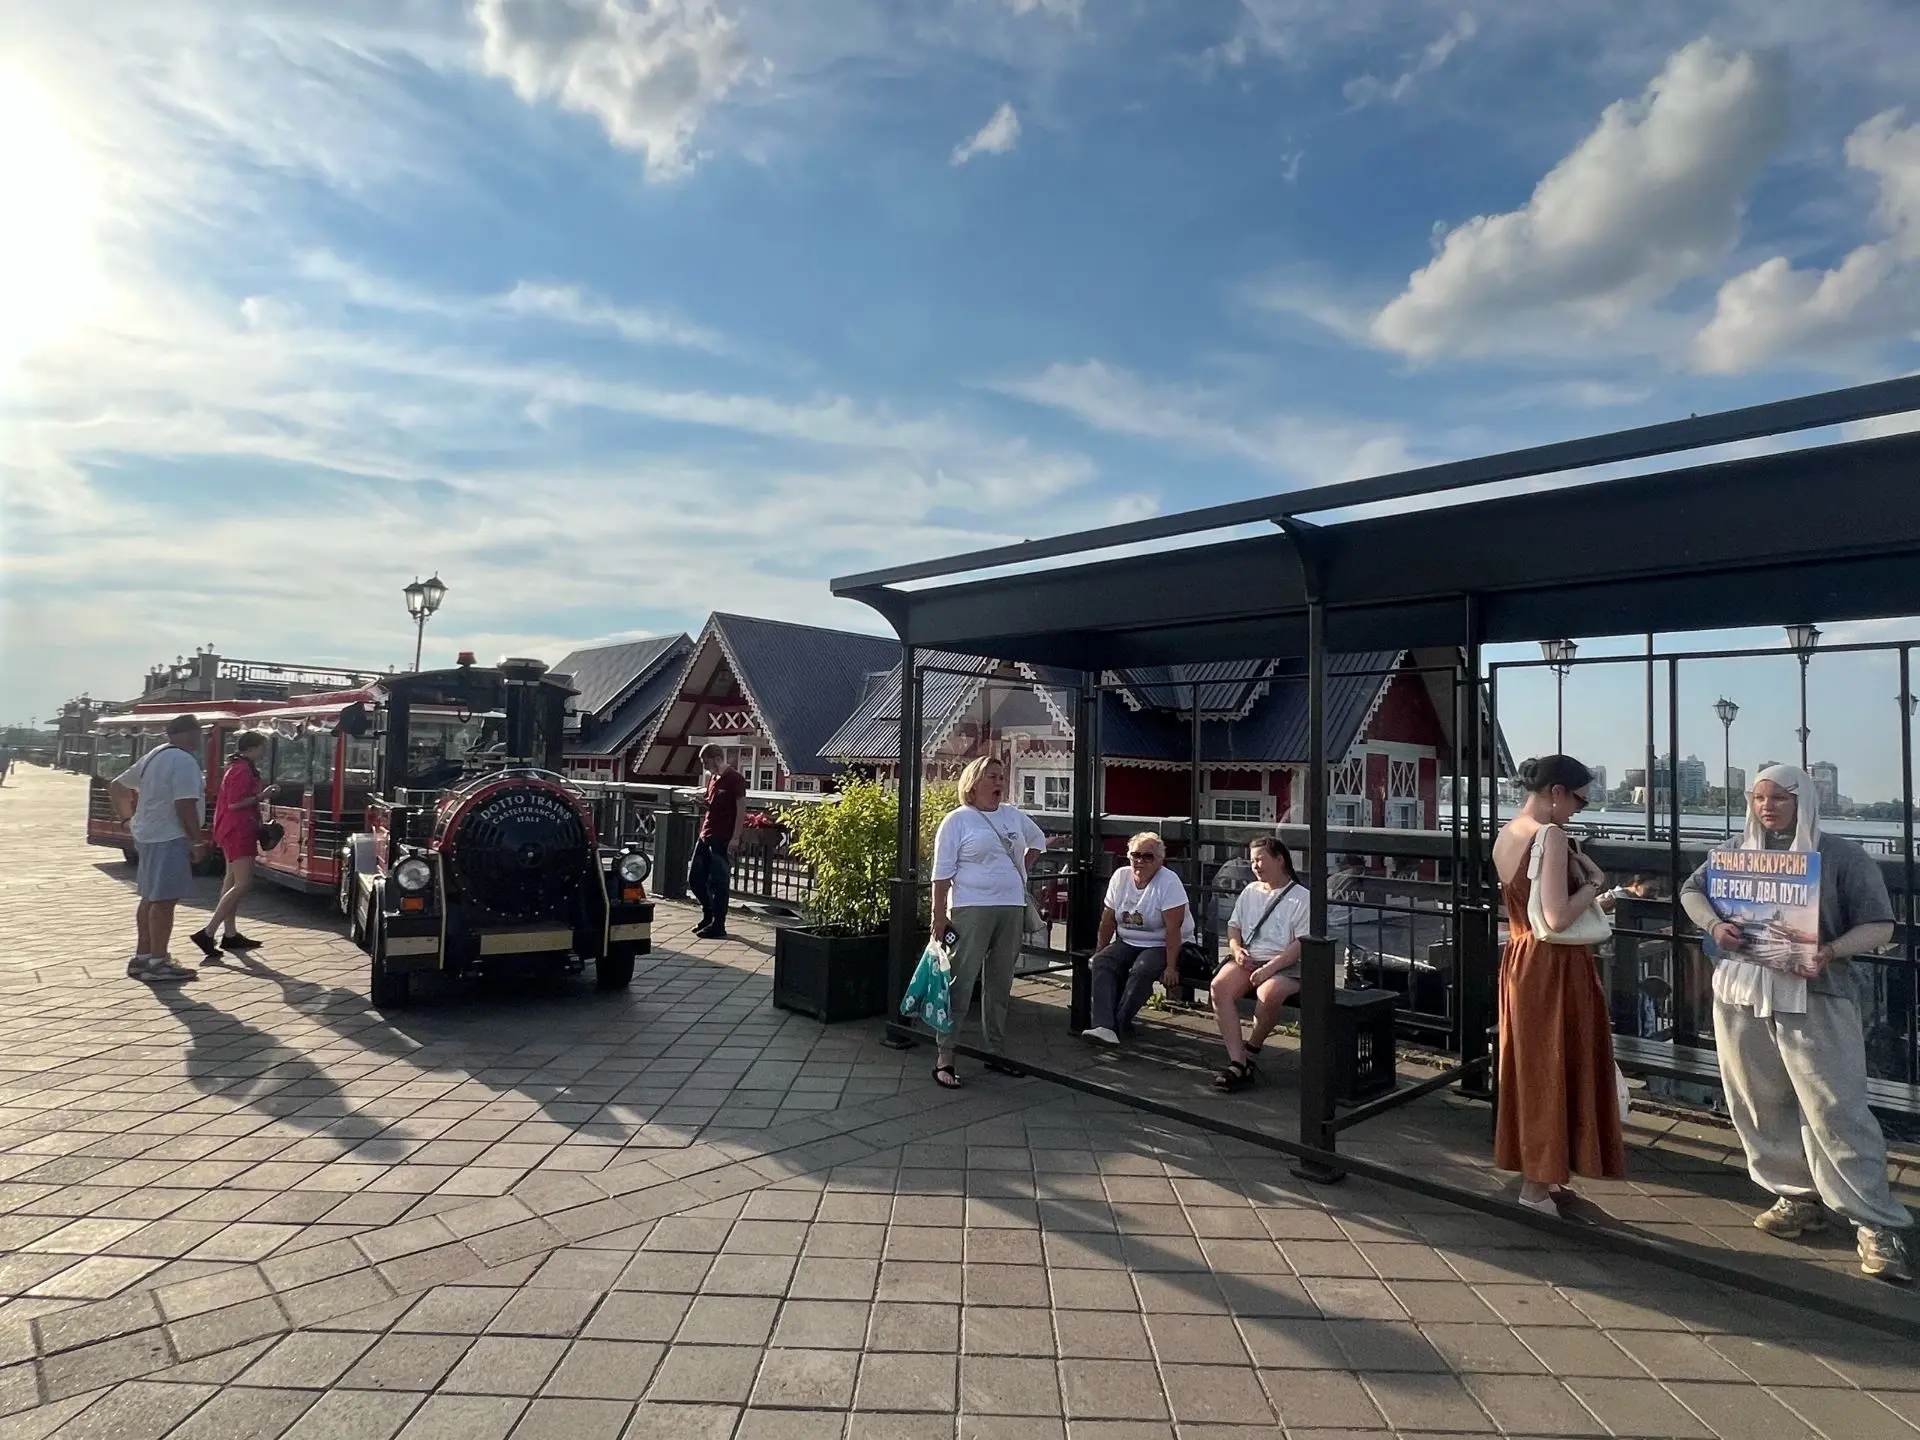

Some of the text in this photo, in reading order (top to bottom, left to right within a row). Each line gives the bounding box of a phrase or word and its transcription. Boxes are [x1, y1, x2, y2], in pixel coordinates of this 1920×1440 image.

[480, 795, 572, 820] DOTTO TRAINS
[1710, 851, 1808, 875] РЕЧНАЯ ЭКСКУРСИЯ
[1709, 878, 1808, 906] ДВЕ РЕКИ, ДВА ПУТИ
